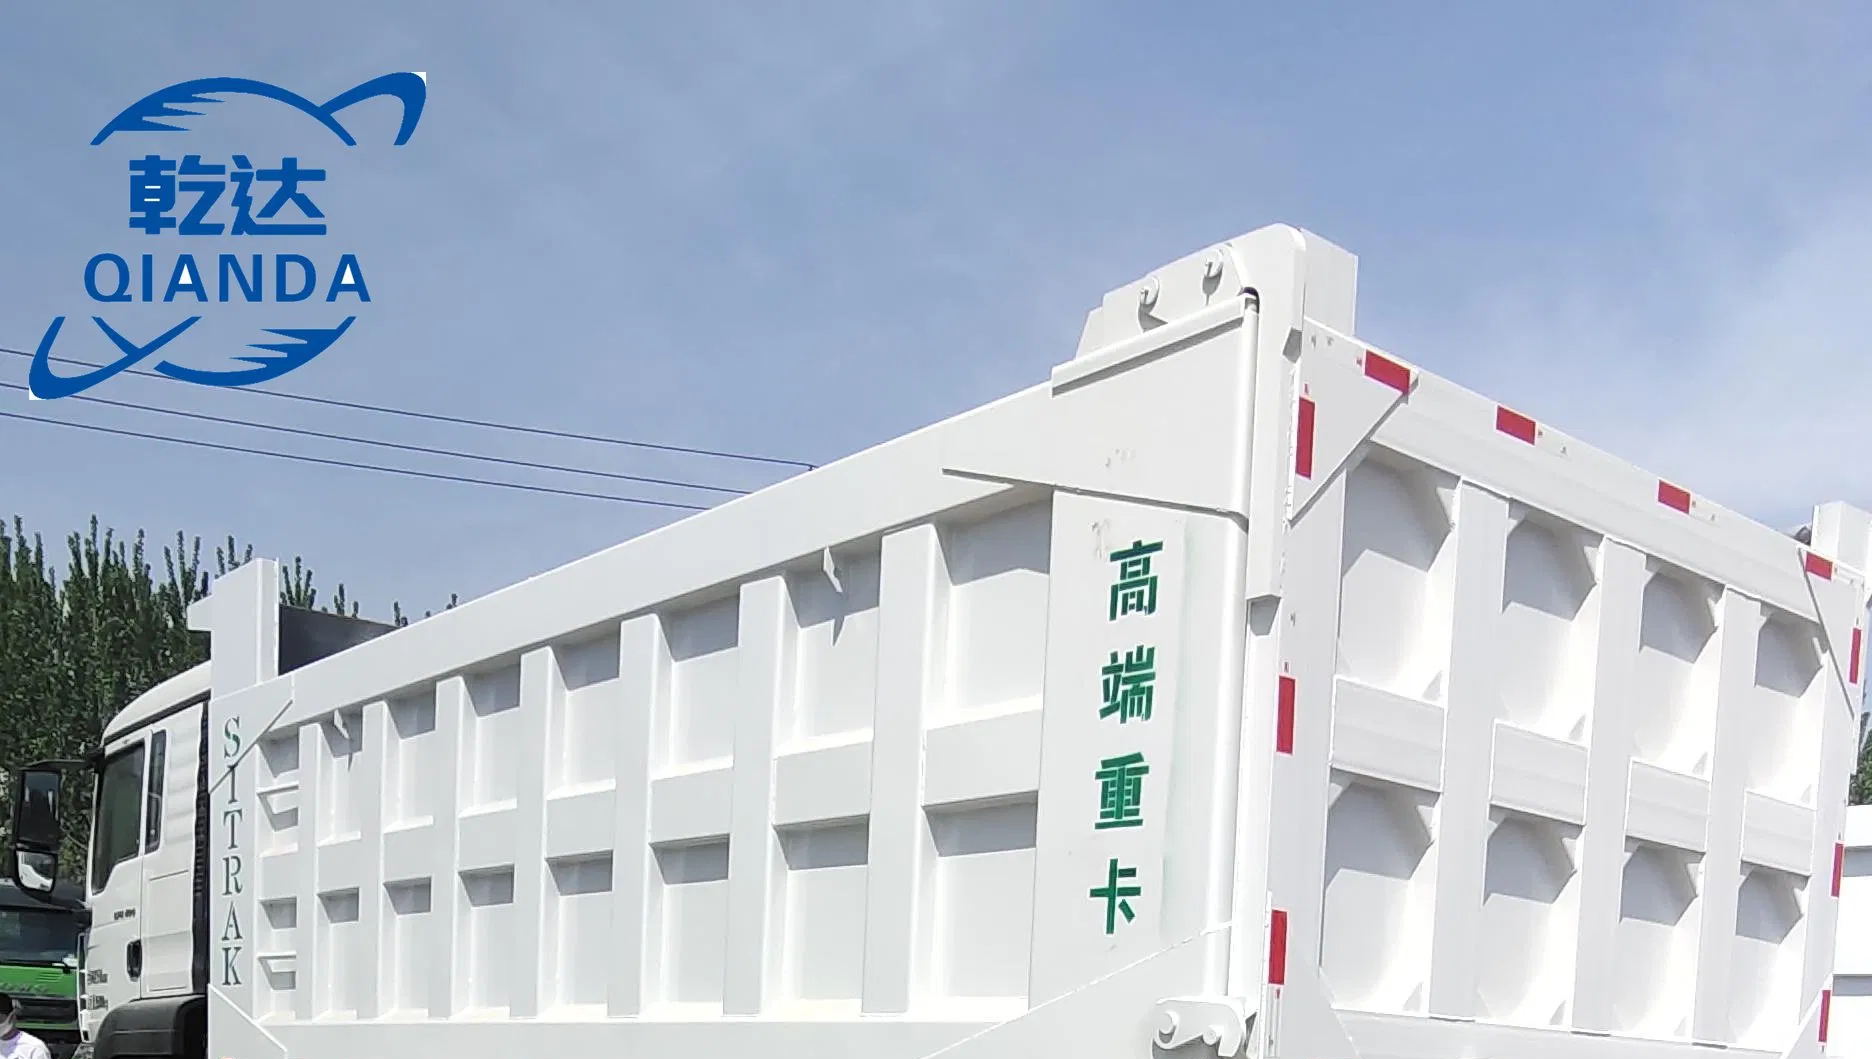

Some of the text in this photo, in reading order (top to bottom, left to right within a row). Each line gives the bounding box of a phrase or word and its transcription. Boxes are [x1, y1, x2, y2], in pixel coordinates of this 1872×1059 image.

[221, 716, 243, 986] SITRAK
[1089, 539, 1163, 934] 高端重卡
